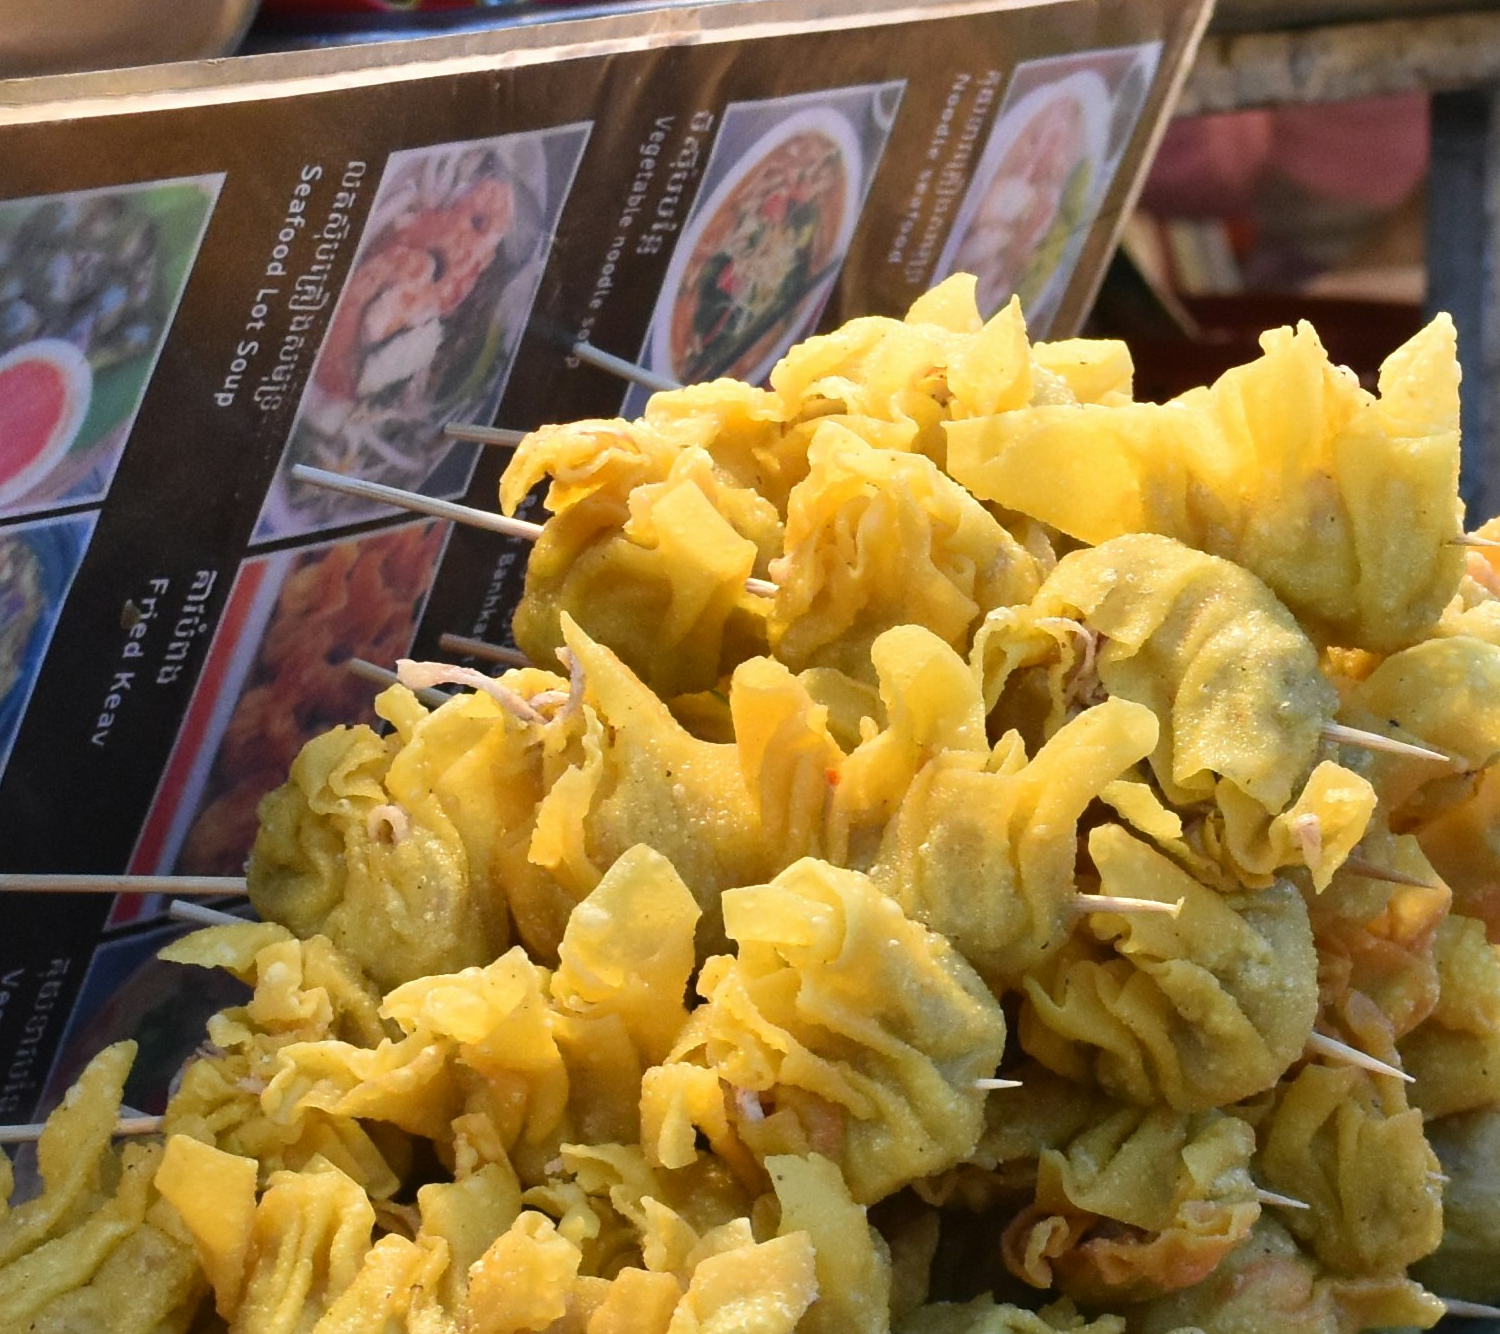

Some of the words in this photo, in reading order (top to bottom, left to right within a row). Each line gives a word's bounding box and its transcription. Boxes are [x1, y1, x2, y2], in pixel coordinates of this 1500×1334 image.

[619, 115, 676, 228] Vegetable
[266, 164, 323, 276] Seafood
[246, 288, 280, 331] Lot
[589, 235, 626, 310] noodle
[214, 340, 259, 407] Soup
[564, 316, 597, 371] sop
[122, 577, 170, 658] Fried
[91, 671, 136, 746] Keav
